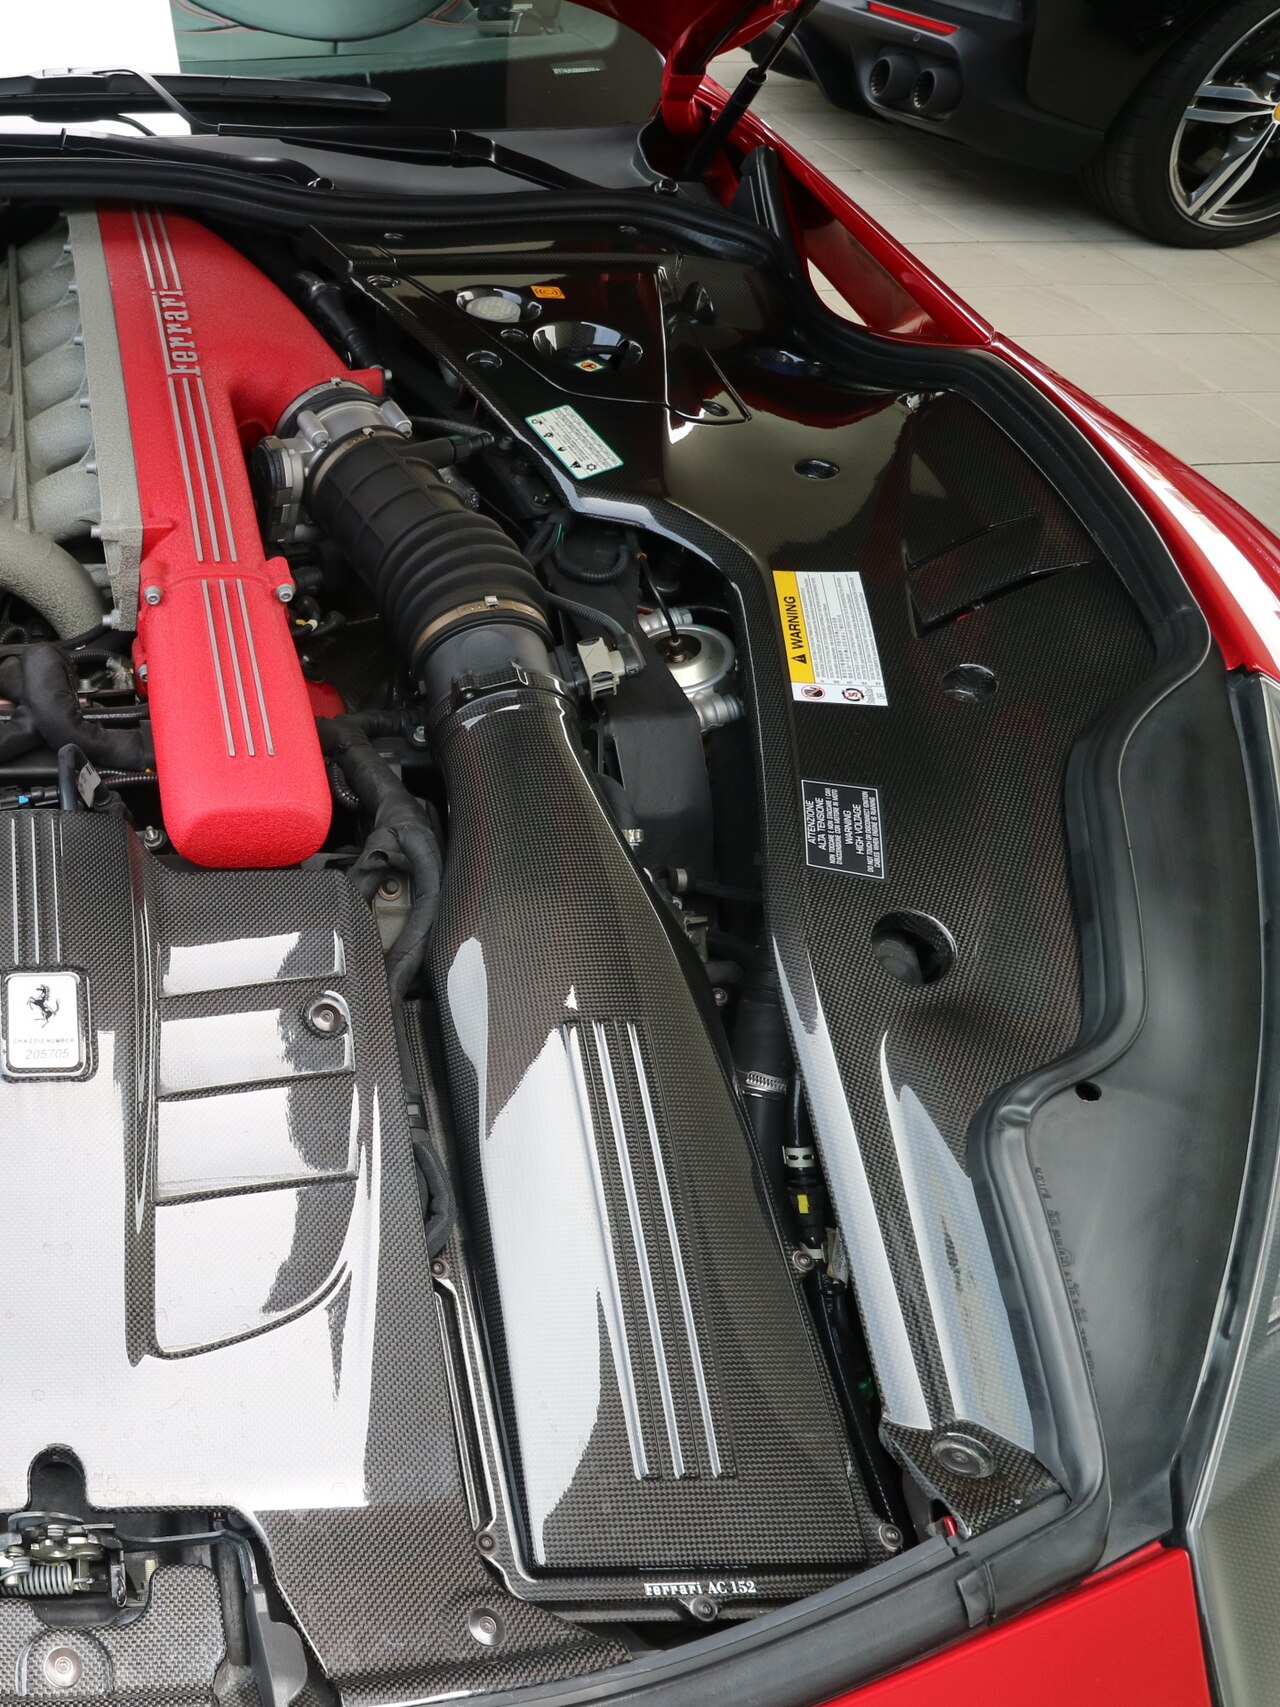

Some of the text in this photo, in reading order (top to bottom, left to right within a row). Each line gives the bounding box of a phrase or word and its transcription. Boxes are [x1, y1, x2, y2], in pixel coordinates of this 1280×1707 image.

[151, 290, 202, 377] Ferrari
[783, 596, 803, 650] WARNING
[806, 800, 816, 844] ATTENZIONE
[815, 797, 826, 850] ALTA TENSIONE
[843, 810, 853, 844] WARNING
[853, 804, 864, 854] HIGH VOLTAGE
[25, 1049, 70, 1060] 205705
[643, 1580, 757, 1596] Ferrari AC 152
